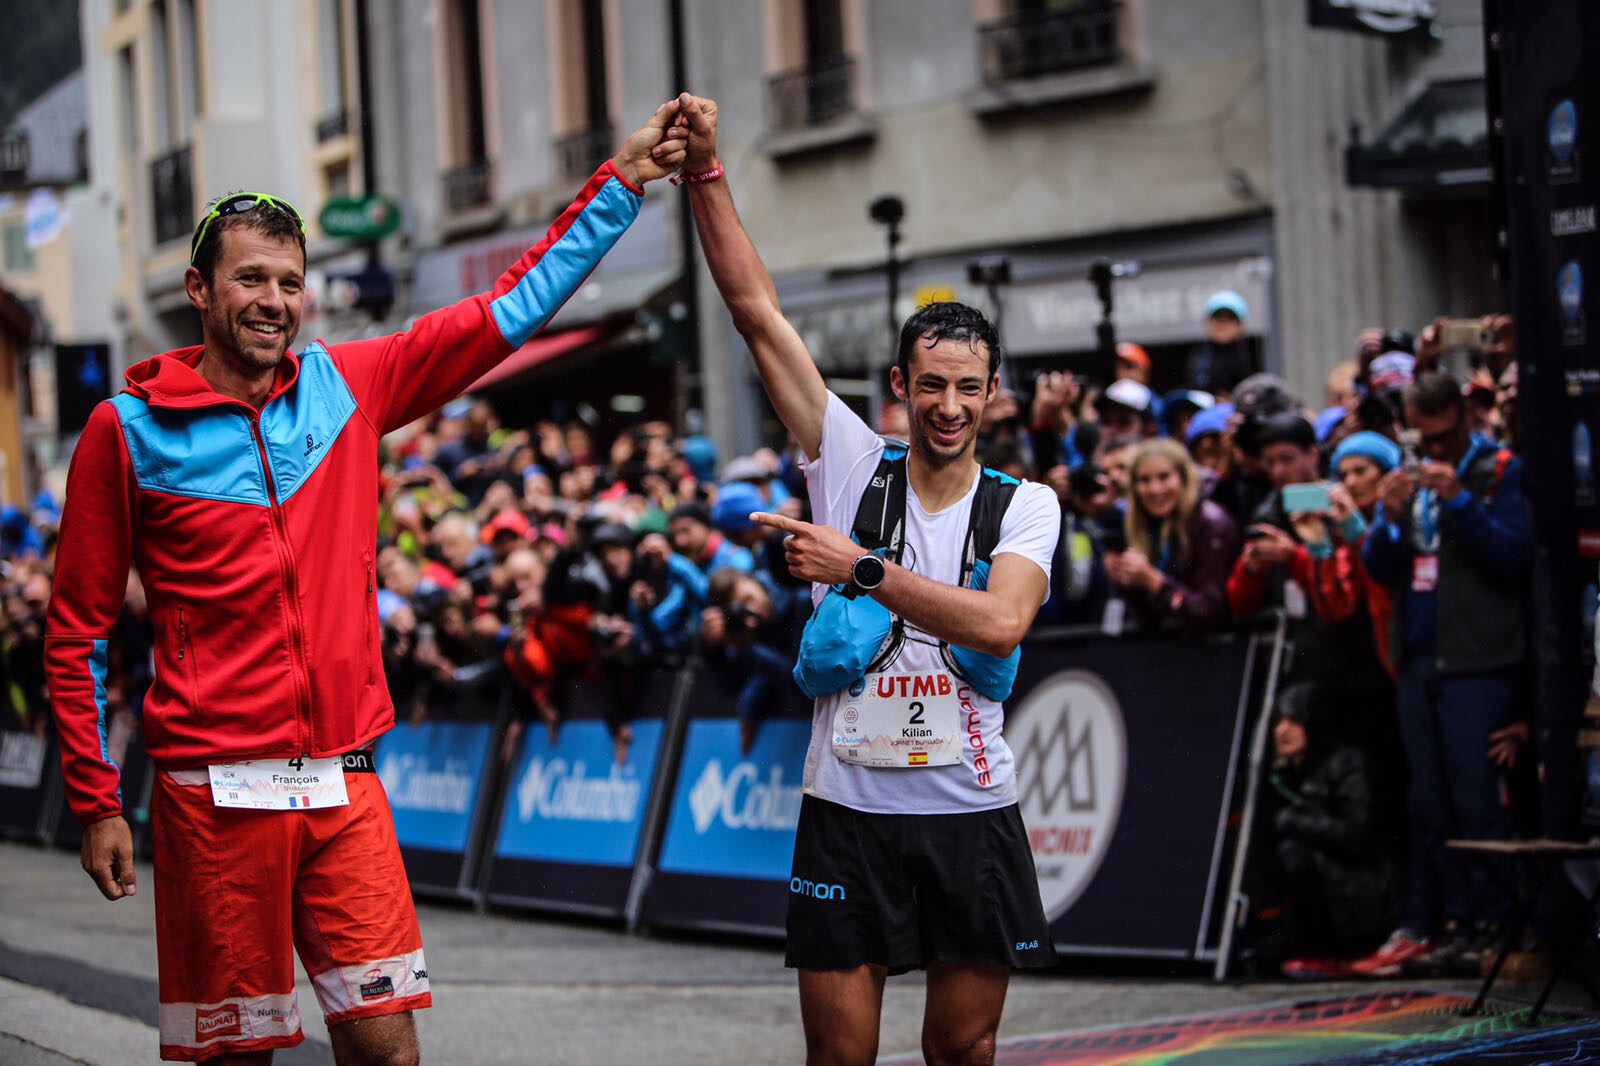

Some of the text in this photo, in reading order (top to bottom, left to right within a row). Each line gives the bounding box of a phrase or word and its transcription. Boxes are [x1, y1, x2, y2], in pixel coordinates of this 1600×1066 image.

[877, 674, 951, 699] UTMB
[908, 701, 925, 725] 2
[902, 728, 933, 738] Kilian
[272, 774, 320, 786] François
[538, 757, 642, 823] Columbia
[790, 877, 846, 899] omon
